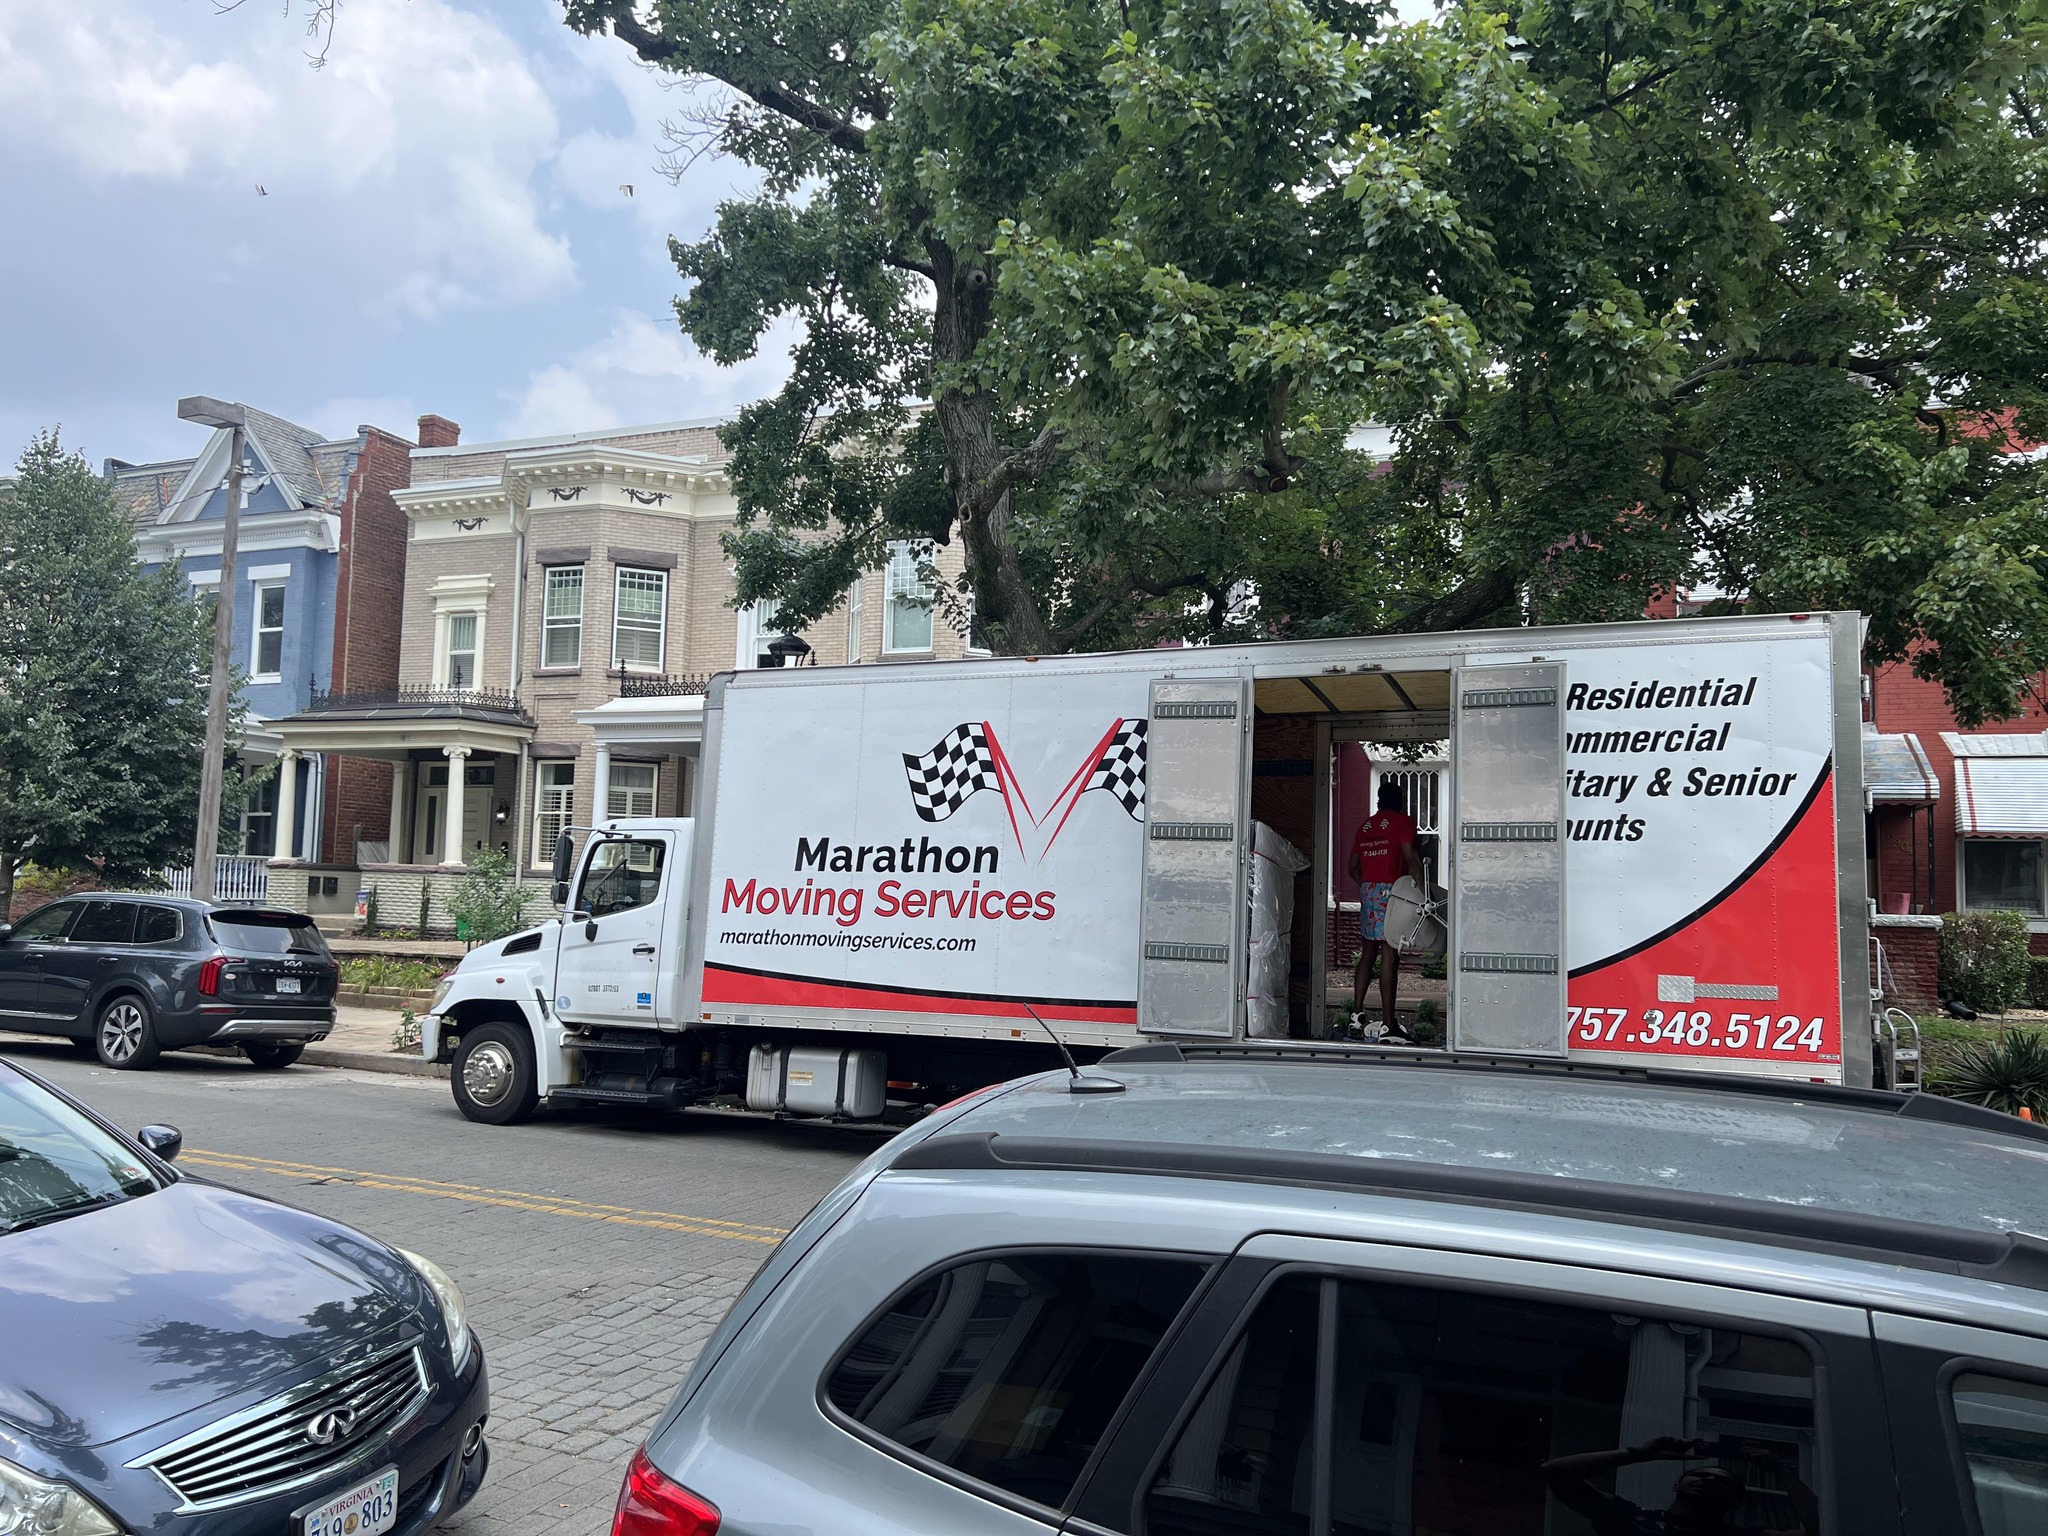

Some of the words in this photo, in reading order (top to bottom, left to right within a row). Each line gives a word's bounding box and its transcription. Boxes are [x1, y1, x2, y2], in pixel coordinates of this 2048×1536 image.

[1567, 676, 1758, 711] Residential
[1646, 766, 1673, 797] &
[1682, 767, 1797, 796] Senior
[794, 837, 999, 874] Marathon
[720, 878, 863, 927] Moving
[874, 879, 1056, 921] Services
[719, 928, 977, 952] marathonmovingservices.com
[1567, 1006, 1825, 1052] 757.348.5124
[329, 1486, 374, 1516] VIRGINIA
[362, 1489, 393, 1528] 803
